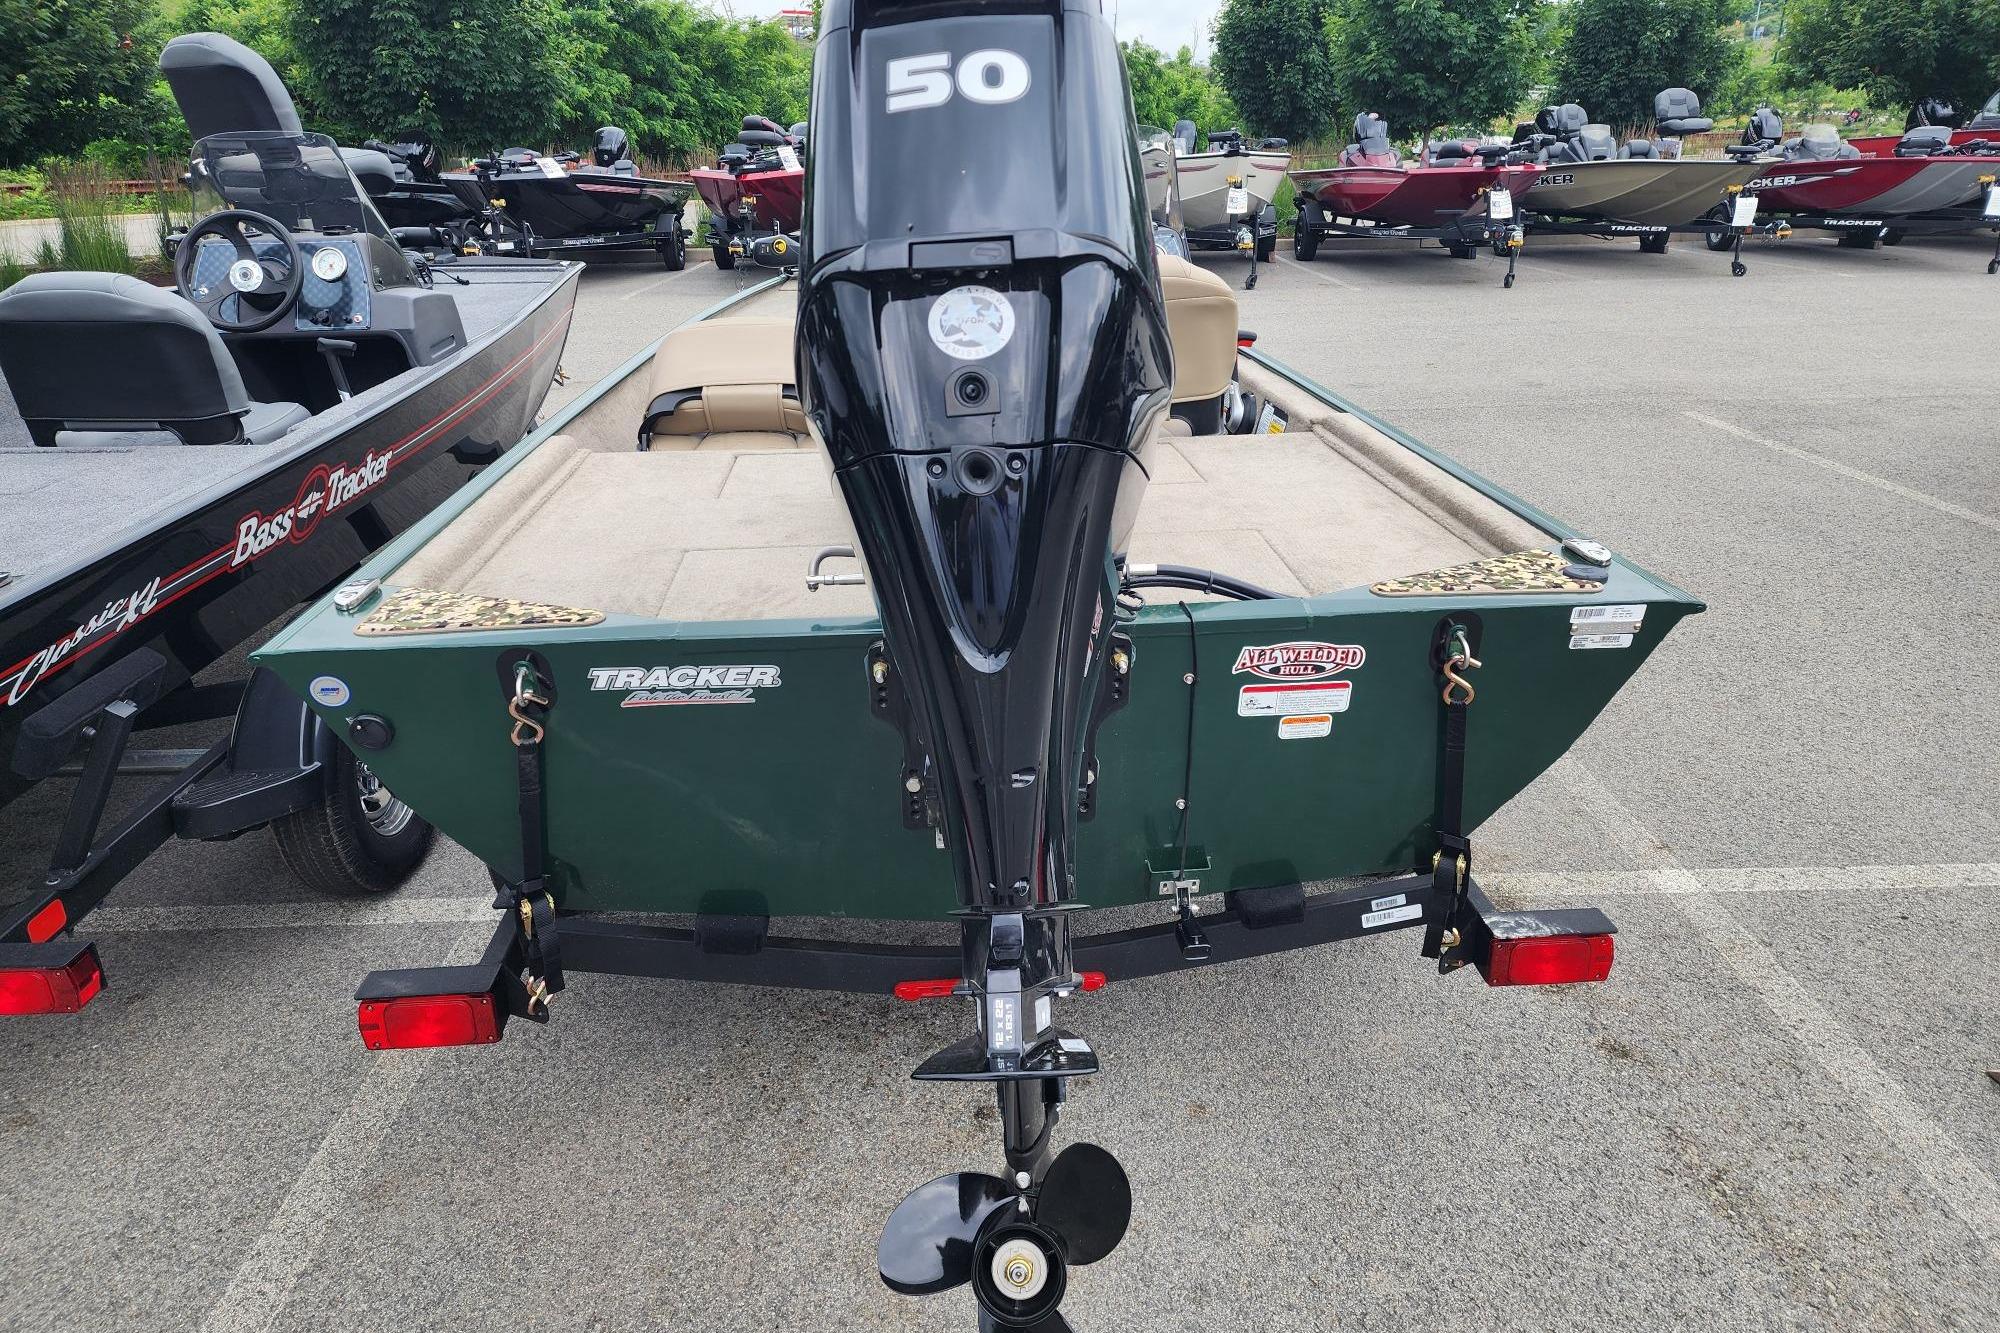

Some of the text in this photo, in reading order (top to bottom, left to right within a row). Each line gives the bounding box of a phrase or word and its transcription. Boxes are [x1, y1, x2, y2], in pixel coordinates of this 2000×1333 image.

[886, 48, 1032, 113] 50
[231, 450, 392, 567] Bass Tracker
[7, 597, 129, 706] Classic
[1235, 647, 1363, 672] ALL WELDED
[1279, 664, 1317, 675] HULL
[995, 999, 1004, 1019] 22
[995, 1032, 1004, 1049] 12
